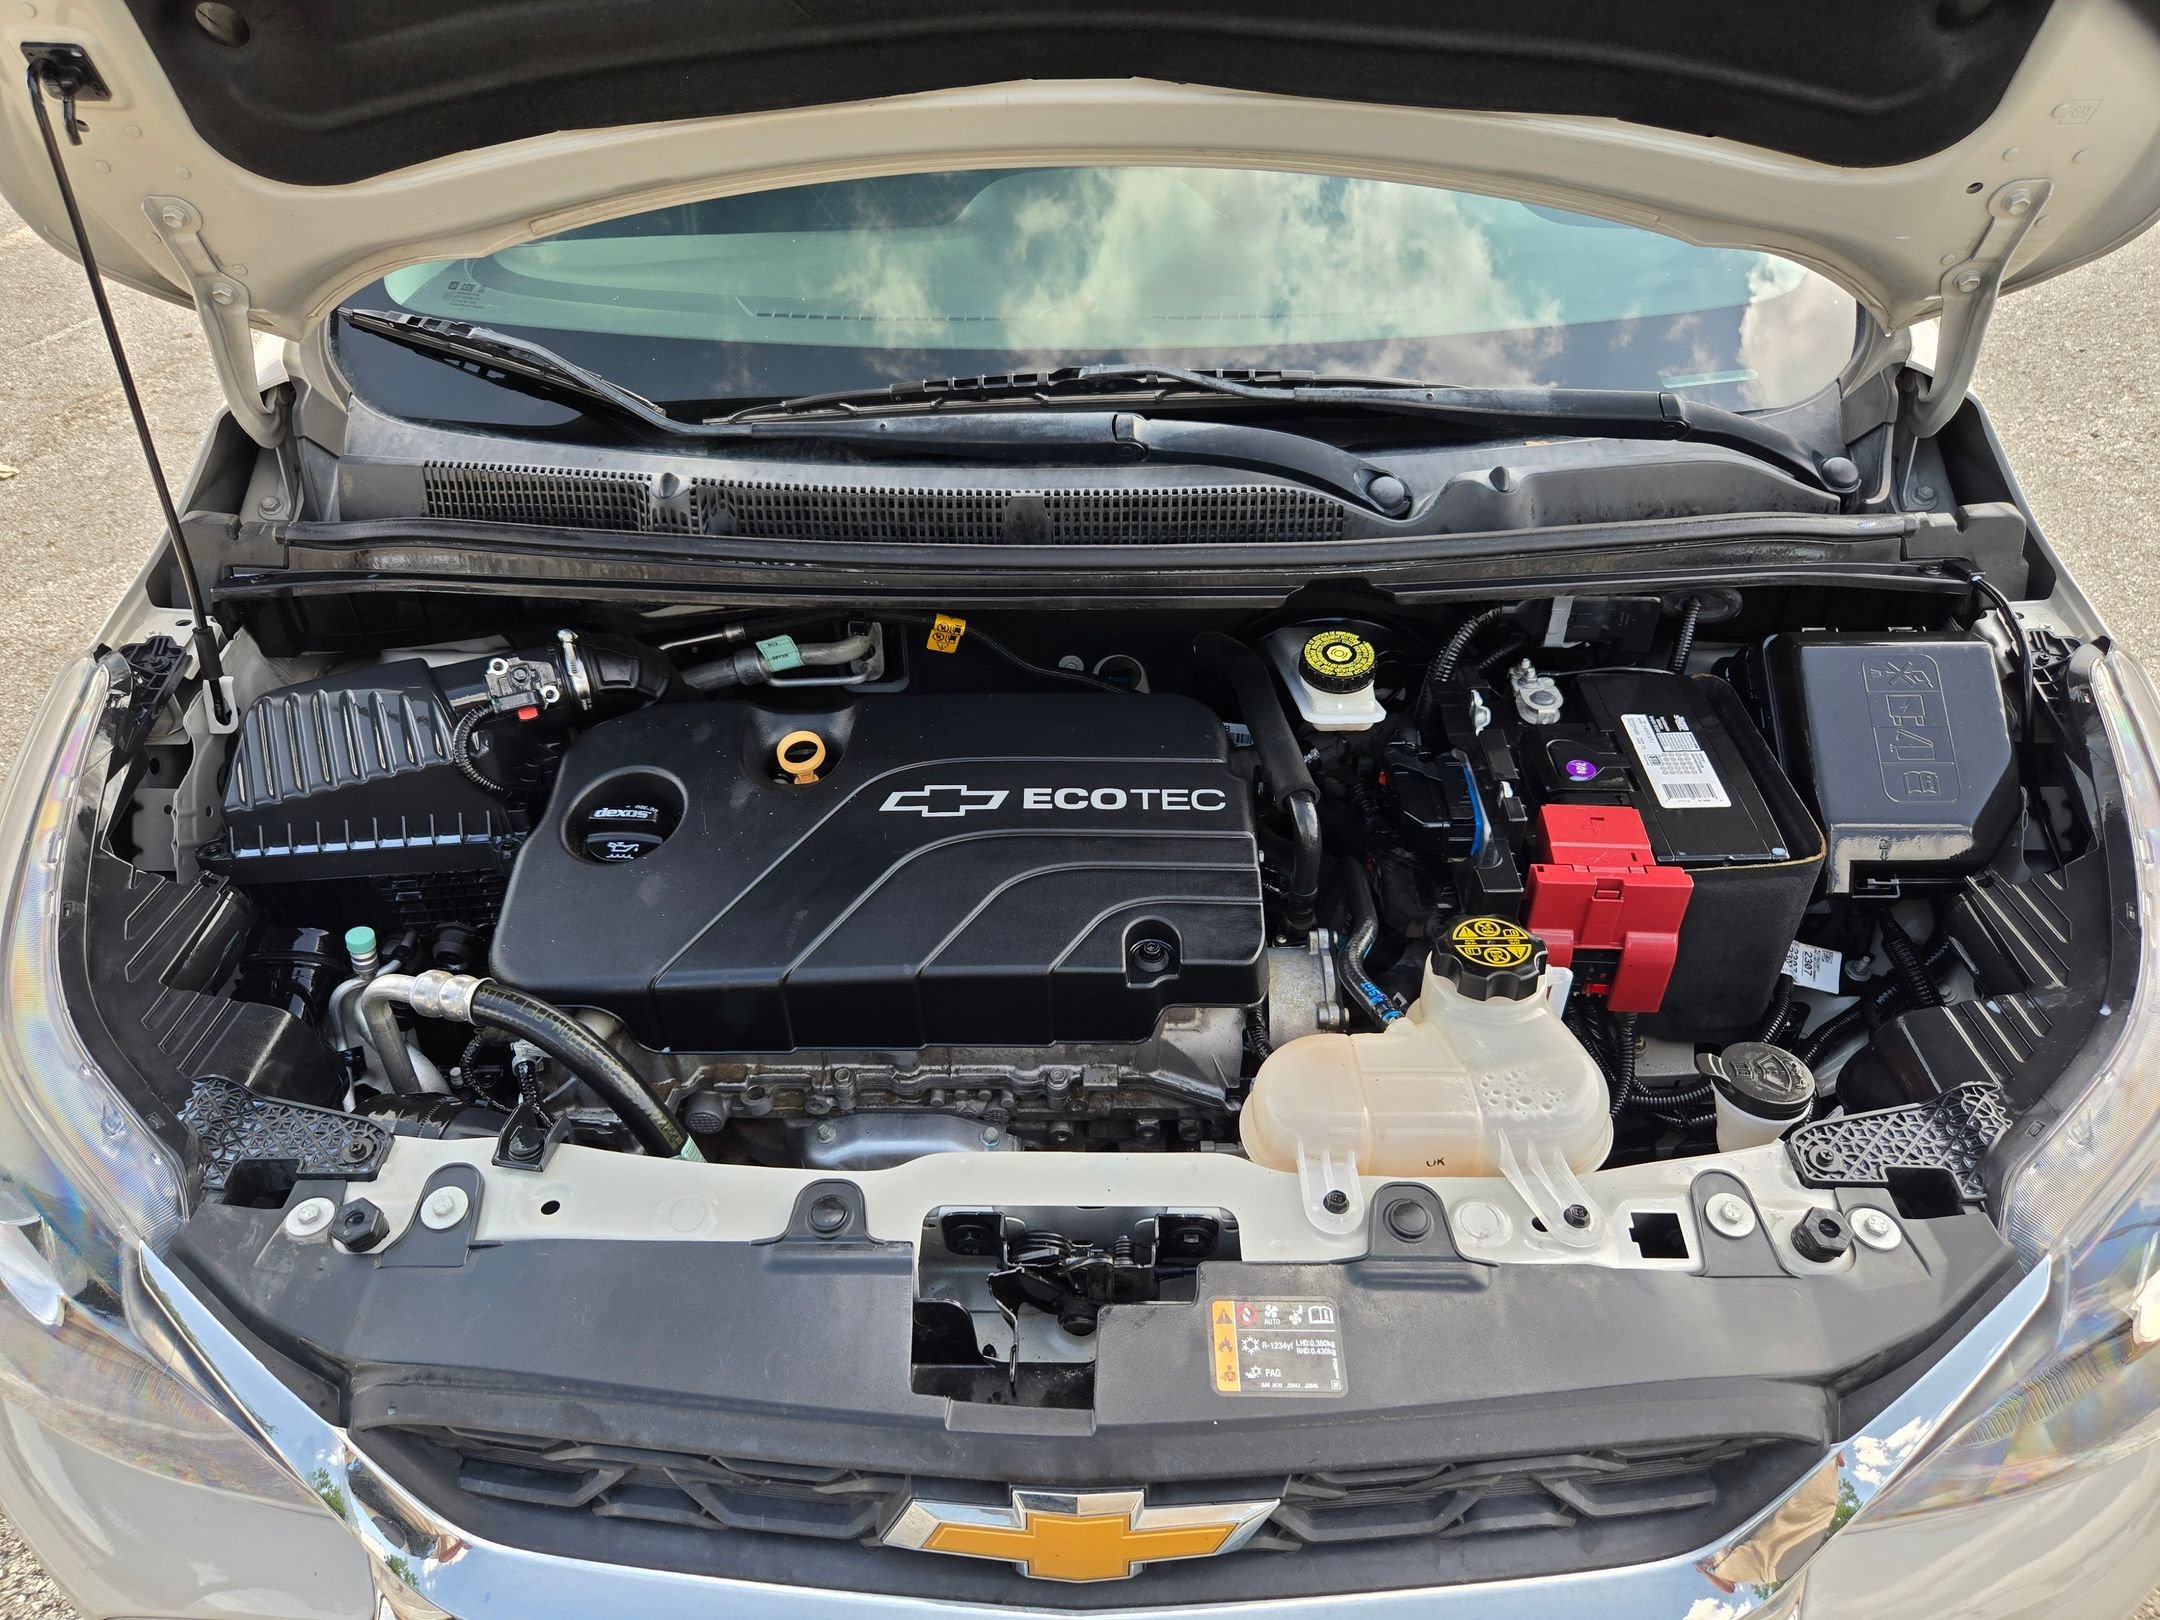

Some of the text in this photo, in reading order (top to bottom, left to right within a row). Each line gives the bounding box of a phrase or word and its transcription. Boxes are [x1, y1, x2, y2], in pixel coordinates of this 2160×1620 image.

[1023, 787, 1226, 811] ECOTEC
[593, 807, 652, 819] dexos
[1803, 950, 1813, 977] 2307
[1261, 1341, 1294, 1351] R-1234yf
[1265, 1368, 1282, 1378] PAG
